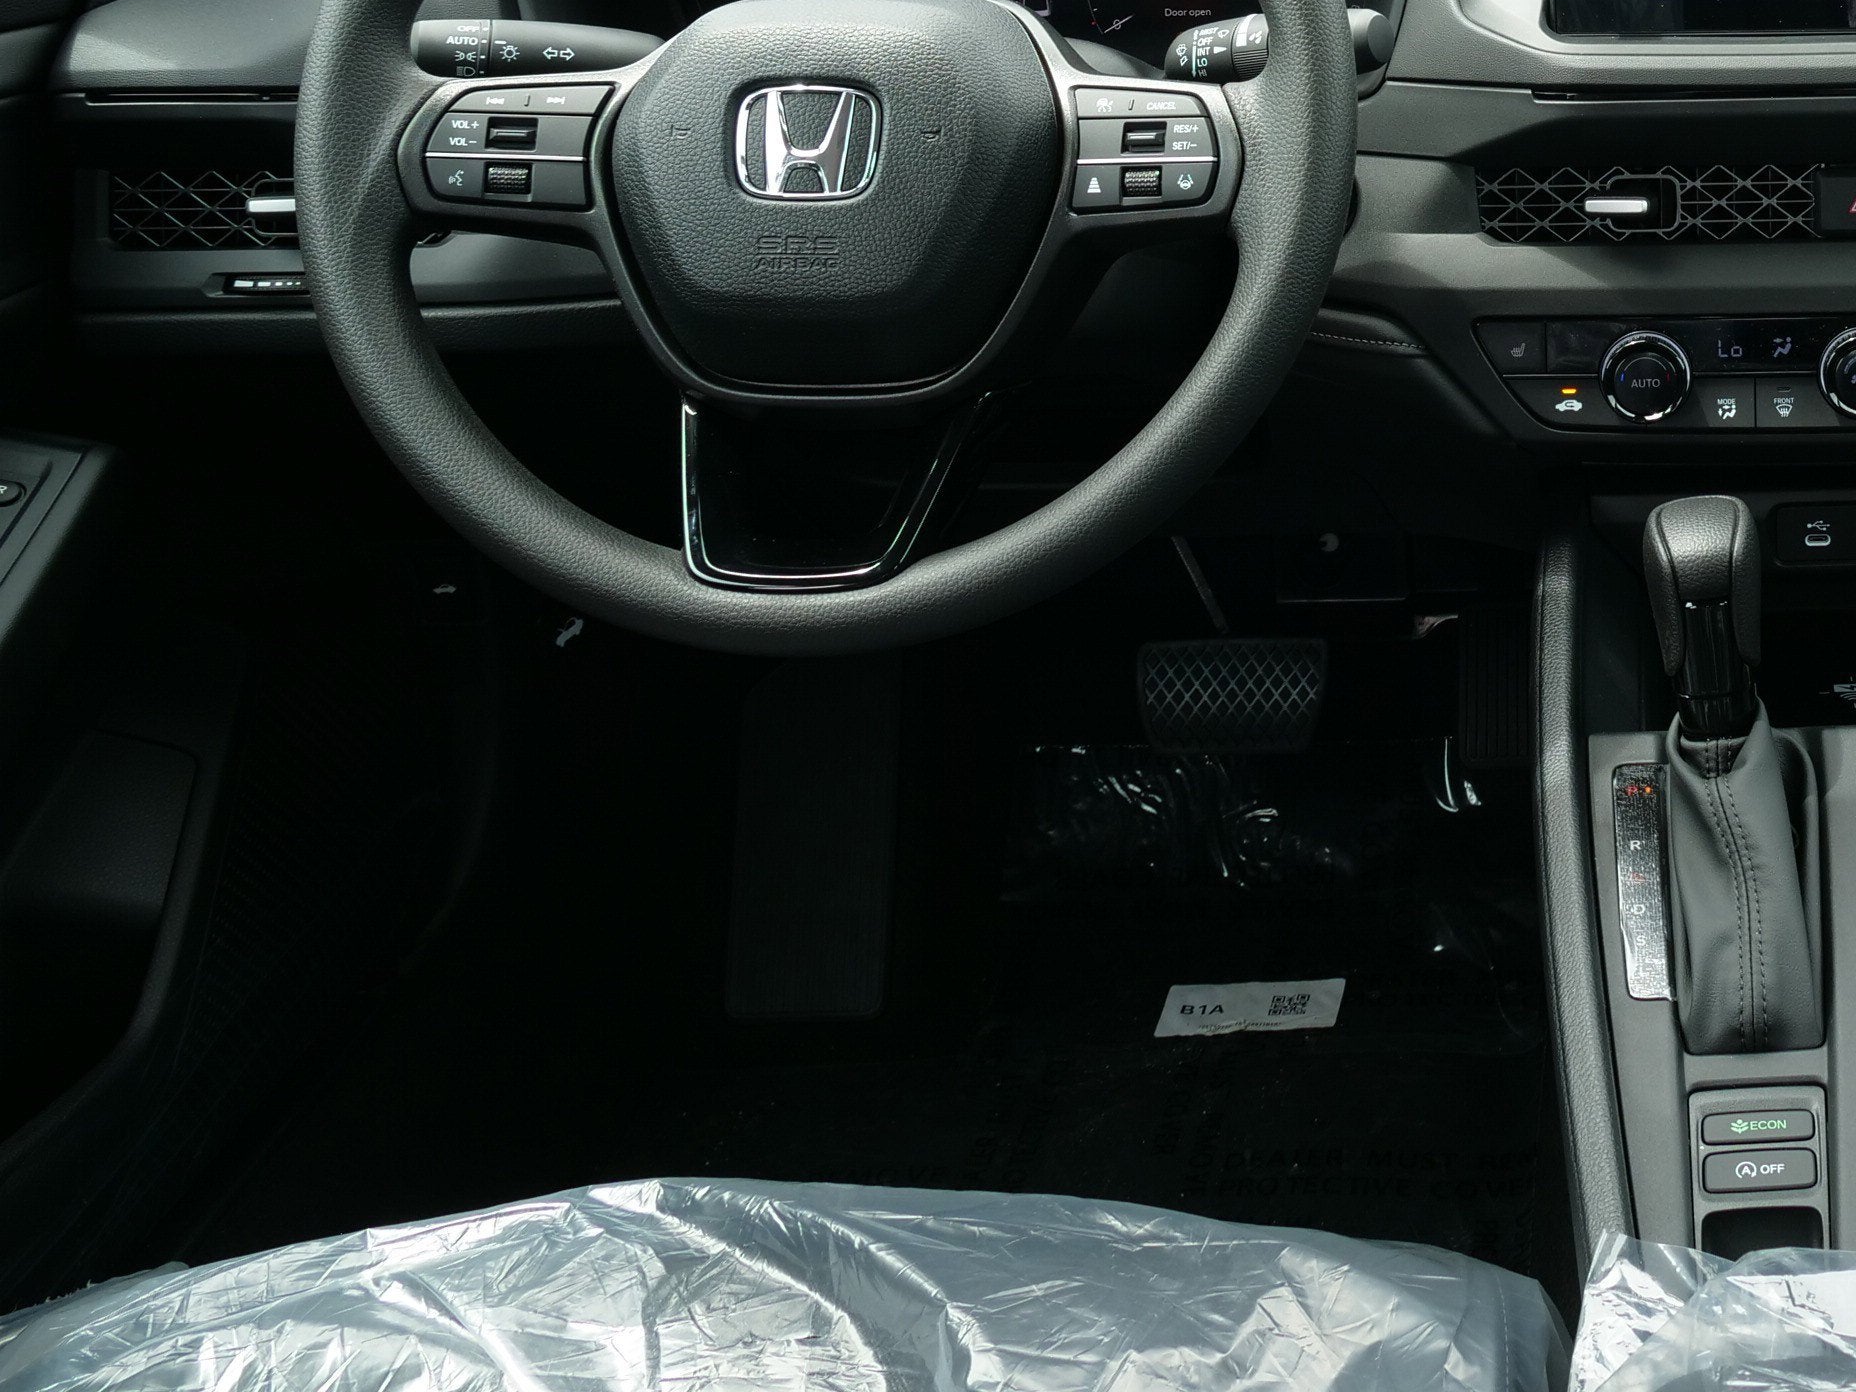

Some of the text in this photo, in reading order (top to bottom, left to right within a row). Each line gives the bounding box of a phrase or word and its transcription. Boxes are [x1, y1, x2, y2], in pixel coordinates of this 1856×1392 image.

[1164, 8, 1212, 18] Door open
[446, 37, 478, 45] AUTO
[1197, 37, 1213, 46] OFF
[1197, 47, 1211, 56] INT
[1197, 58, 1208, 67] LO
[1146, 101, 1176, 110] CANCEL
[757, 235, 840, 254] SRS
[752, 258, 840, 271] AIRBAG
[1631, 379, 1660, 388] AUTO
[1630, 840, 1641, 850] R
[1180, 1004, 1224, 1015] B1A
[1750, 1119, 1787, 1130] ECON
[1760, 1163, 1785, 1175] OFF
